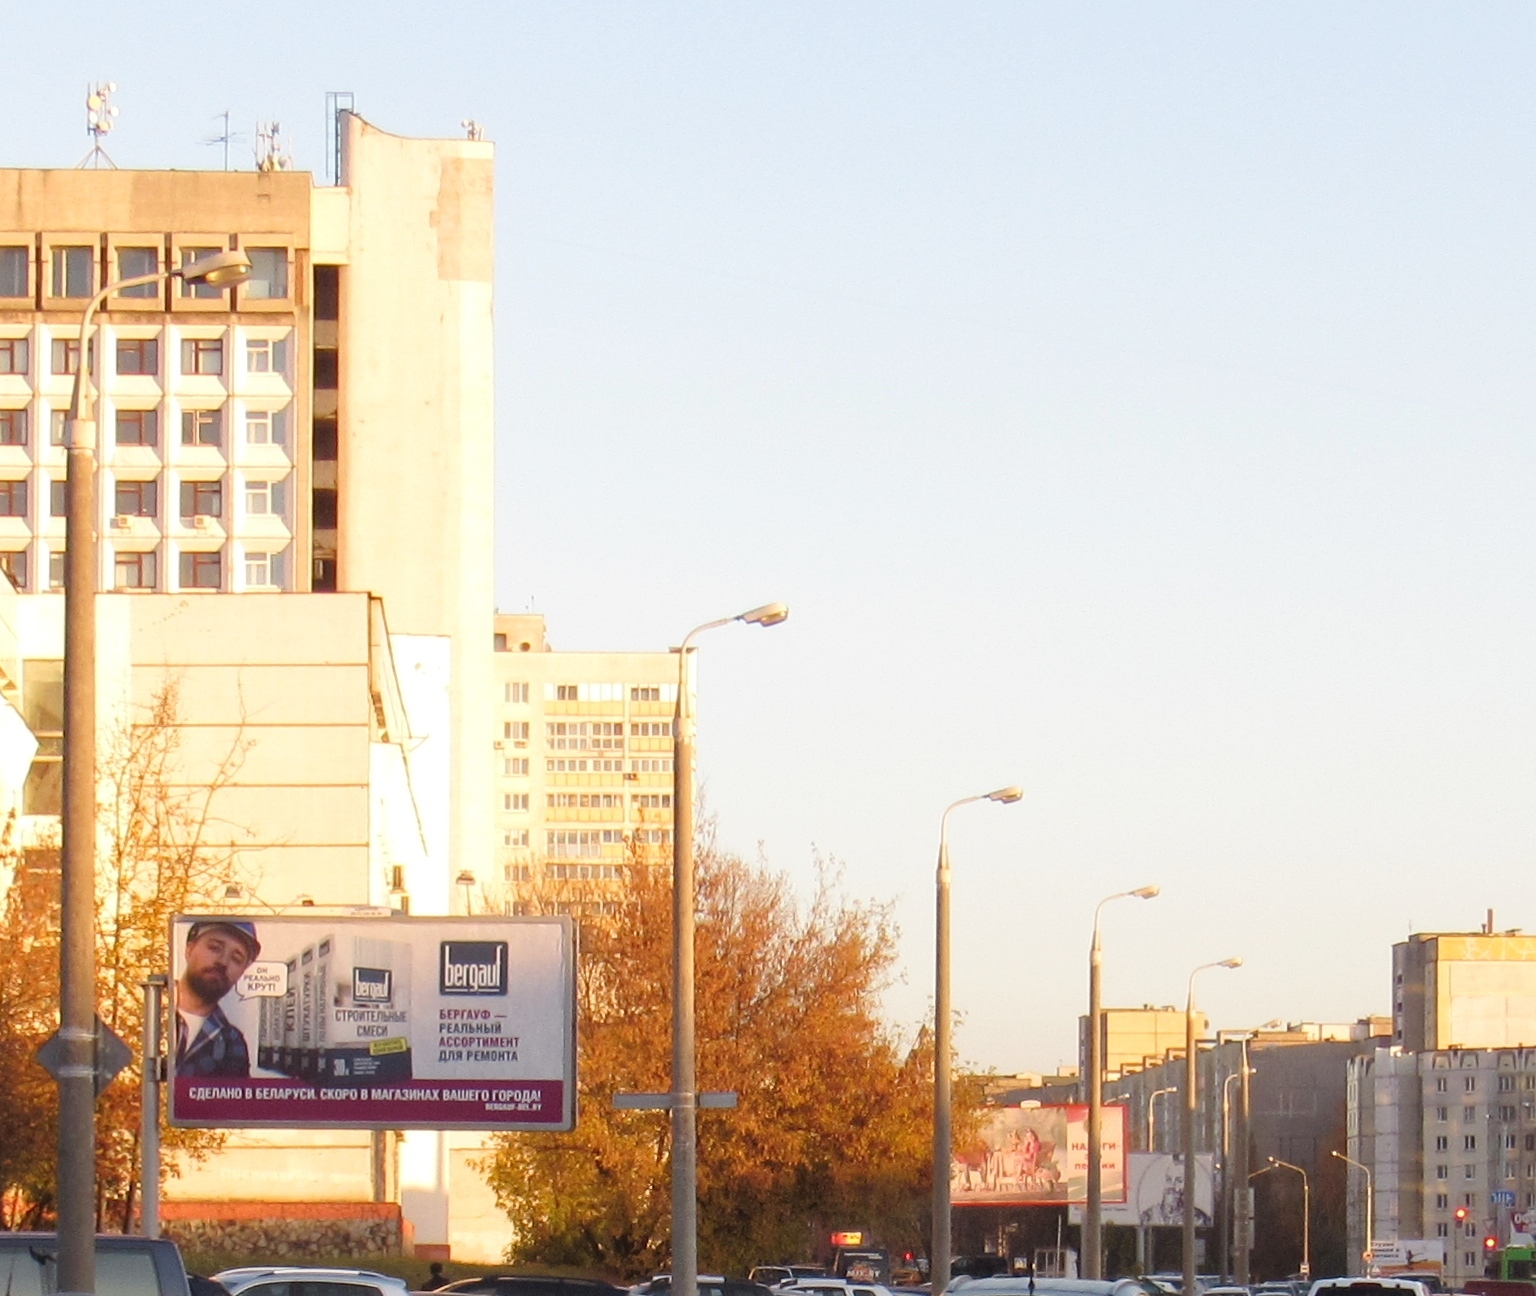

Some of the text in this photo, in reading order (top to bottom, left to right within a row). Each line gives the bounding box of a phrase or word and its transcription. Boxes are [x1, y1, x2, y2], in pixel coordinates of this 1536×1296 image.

[445, 945, 504, 992] bergauf
[243, 974, 281, 982] РЕАЛЬНО
[355, 969, 390, 999] bergauf
[247, 983, 276, 991] КРУТ!
[335, 1009, 407, 1023] СТРОИТЕЛЬНЫЕ
[439, 1009, 491, 1020] БЕРГАУФ
[357, 1025, 388, 1037] СМЕСИ
[439, 1022, 502, 1034] РЕАЛЬНЫЙ
[438, 1037, 520, 1048] АССОРТИМЕНТ
[438, 1050, 519, 1062] ДЛЯ РЕМОНТА
[189, 1087, 542, 1103] СДЕЛАНО В БЕЛАРУСИ. СКОРО В МАГАЗИНАХ ВАШЕГО ГОРОДА!
